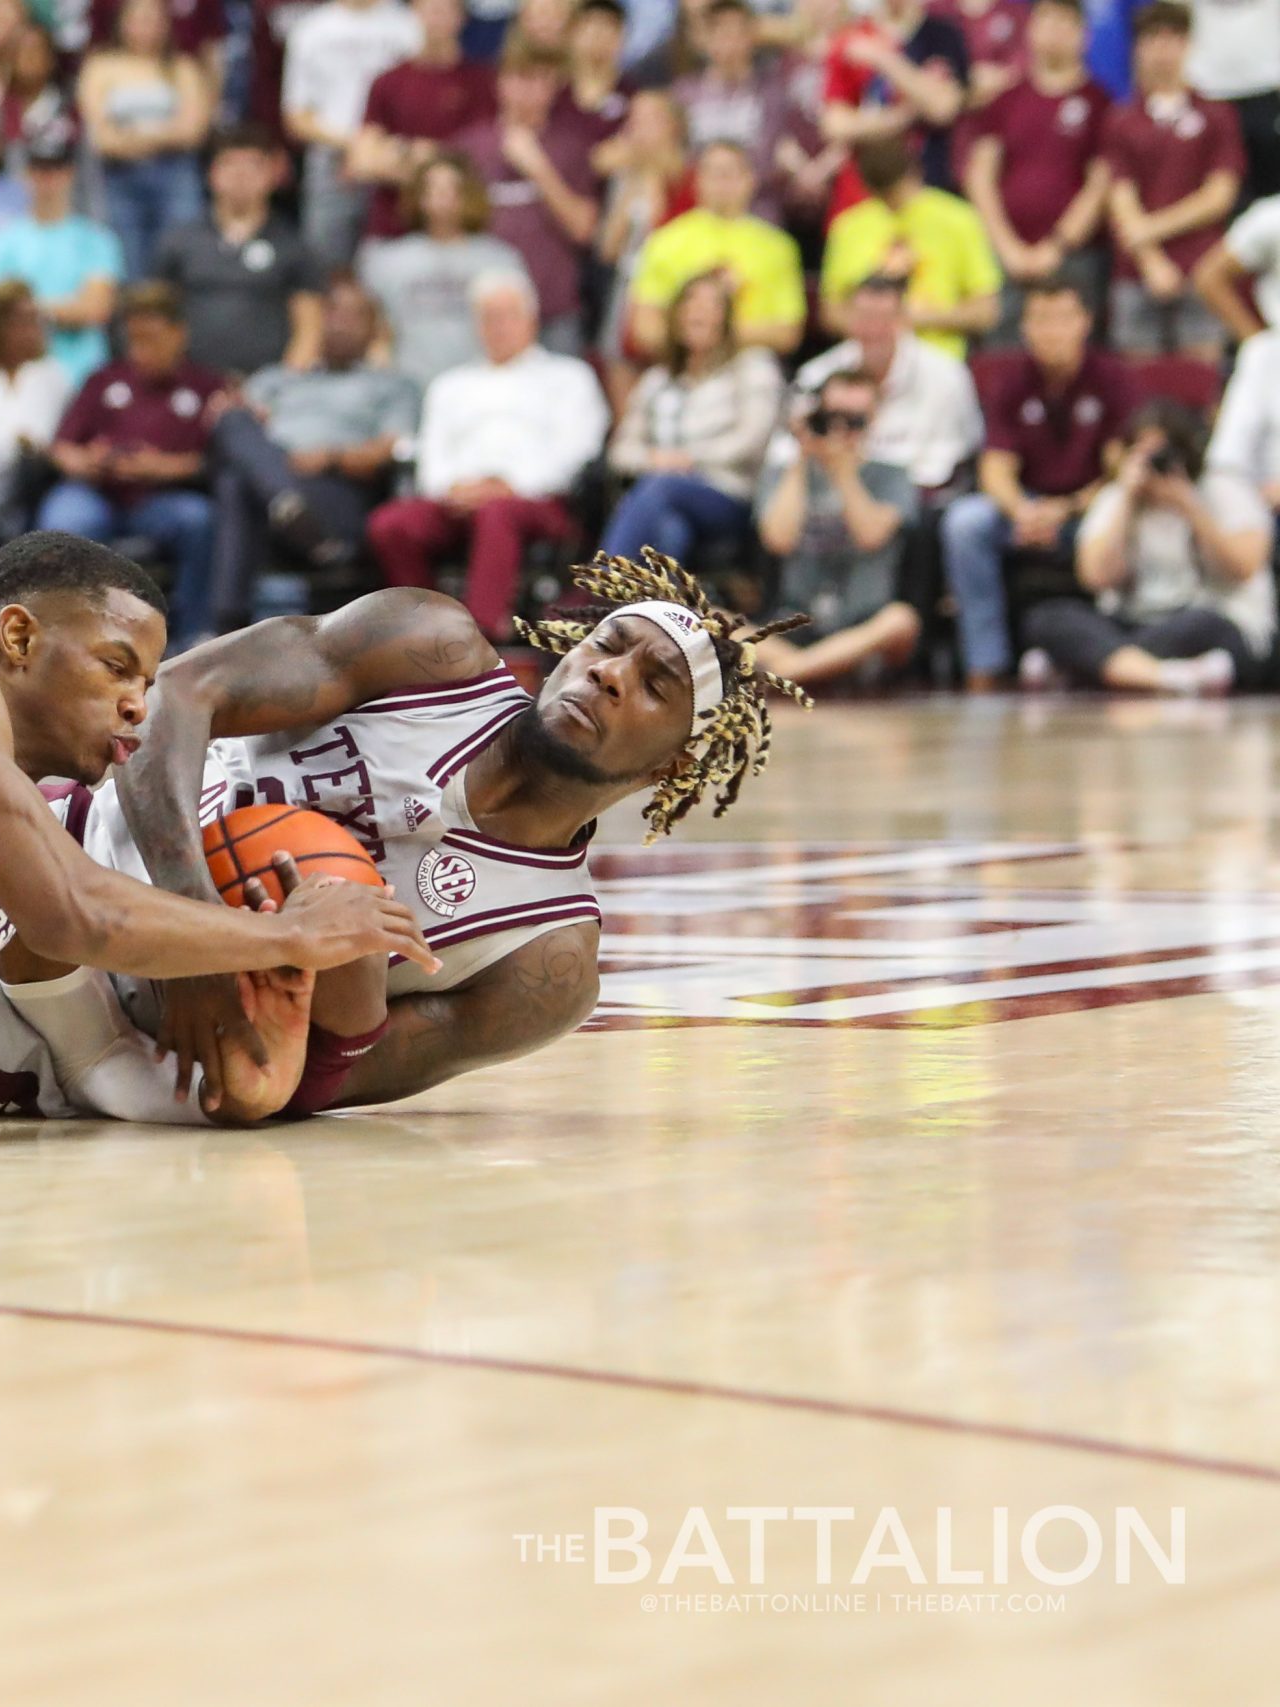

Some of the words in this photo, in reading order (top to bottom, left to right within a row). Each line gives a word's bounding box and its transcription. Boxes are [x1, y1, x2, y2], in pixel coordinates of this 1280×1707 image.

[663, 611, 690, 636] adidas
[290, 725, 386, 864] TEX
[403, 796, 416, 832] adidas
[418, 859, 442, 911] GRADUATE
[433, 856, 475, 903] SEC
